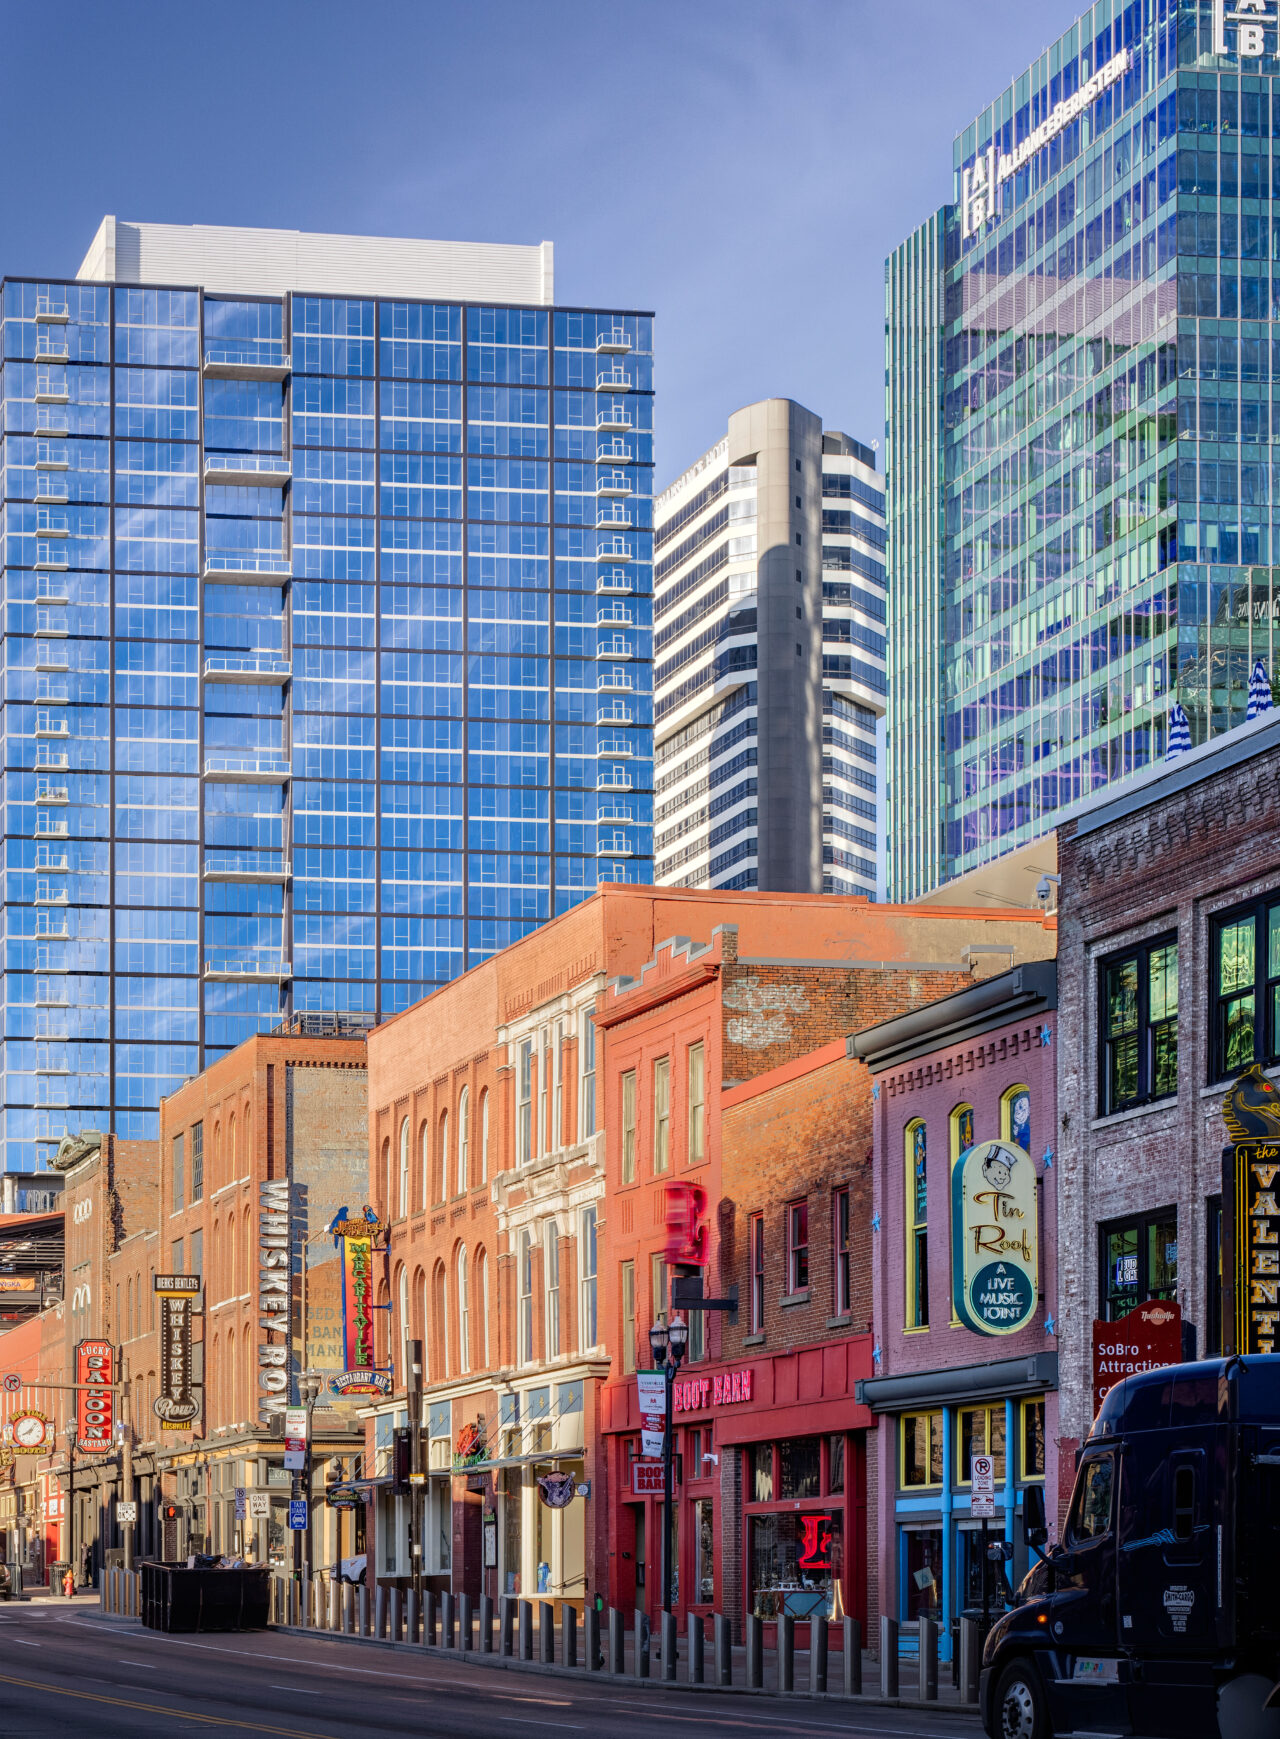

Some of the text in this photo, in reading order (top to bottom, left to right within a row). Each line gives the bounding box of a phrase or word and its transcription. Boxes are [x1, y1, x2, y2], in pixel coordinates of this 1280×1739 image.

[1255, 1148, 1278, 1160] the
[973, 1191, 1025, 1222] Tin
[969, 1225, 1033, 1262] Roof
[1251, 1163, 1280, 1354] VALENTI
[996, 1263, 1007, 1275] A
[987, 1277, 1015, 1291] LIVE
[260, 1178, 288, 1425] WHISKEY ROW
[351, 1243, 369, 1366] MARGARITAVILLE
[979, 1293, 1024, 1305] MUSIC
[983, 1307, 1023, 1320] JOINT
[80, 1346, 111, 1356] LUCKY
[169, 1299, 190, 1401] WHISKEY
[1099, 1344, 1139, 1356] SoBro
[334, 1371, 388, 1389] RESTAURANT BAR
[86, 1356, 105, 1439] SALOON
[674, 1369, 752, 1412] BOOT BARN
[163, 1397, 194, 1419] Row
[79, 1438, 112, 1448] BASTARD
